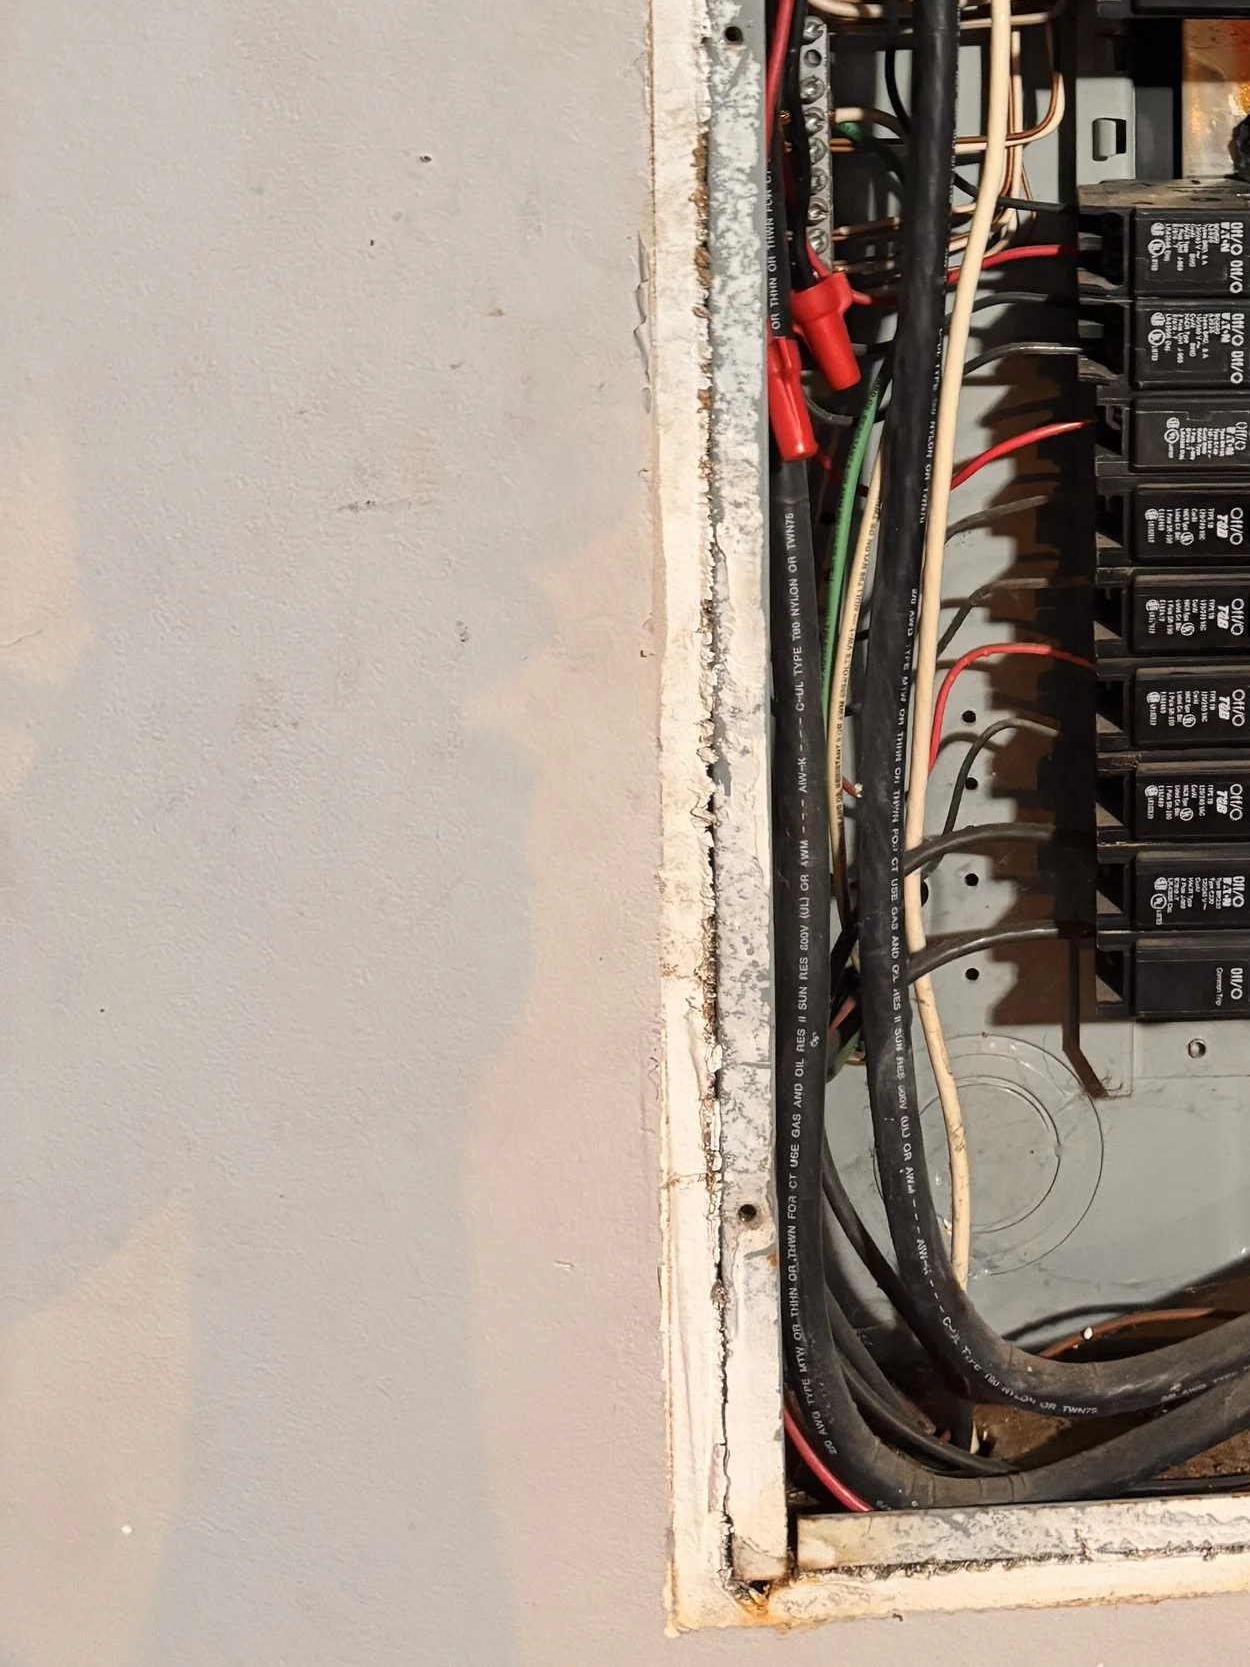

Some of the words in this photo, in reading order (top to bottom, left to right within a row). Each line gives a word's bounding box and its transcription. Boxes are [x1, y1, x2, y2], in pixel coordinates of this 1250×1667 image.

[766, 217, 776, 251] THWN
[1229, 222, 1244, 256] Off/O
[768, 255, 777, 273] OR
[1229, 260, 1244, 294] Off/O
[769, 277, 780, 308] THHN
[771, 313, 781, 330] OR
[1230, 313, 1245, 347] Off/O
[1230, 350, 1244, 384] Off/O
[926, 420, 937, 459] NYLON
[1234, 421, 1248, 451] Off/O
[1229, 507, 1244, 545] Off/O
[786, 555, 798, 574] OR
[788, 577, 800, 617] NYLON
[1230, 598, 1245, 636] Off/O
[792, 645, 803, 676] TYPE
[897, 707, 906, 725] OR
[1231, 689, 1246, 727] Off/O
[1229, 783, 1244, 821] Off/O
[799, 839, 810, 868] AWM
[890, 856, 900, 874] CT
[799, 873, 810, 892] OR
[890, 878, 900, 902] USE
[1232, 875, 1245, 908] Off/O
[799, 896, 810, 919] (UL)
[890, 906, 900, 931] GAS
[799, 924, 810, 951] 600V
[890, 935, 900, 960] AND
[798, 956, 809, 980] RES
[1215, 967, 1223, 993] Common
[1230, 967, 1243, 999] Off/O
[797, 986, 809, 1011] SUN
[1215, 993, 1223, 1006] Trip
[796, 1028, 807, 1052] RES
[894, 1027, 905, 1052] SUN
[794, 1057, 806, 1078] OIL
[895, 1056, 906, 1080] RES
[793, 1082, 804, 1109] AND
[790, 1113, 802, 1139] GAS
[899, 1115, 911, 1138] (UL)
[789, 1143, 800, 1168] USE
[902, 1143, 913, 1162] OR
[788, 1173, 799, 1191] CT
[787, 1195, 797, 1220] FOR
[787, 1225, 797, 1259] THWN
[788, 1264, 798, 1283] OR
[788, 1286, 800, 1319] THHN
[791, 1323, 804, 1342] OR
[795, 1346, 809, 1374] MTW
[800, 1377, 818, 1406] TYPE
[1039, 1400, 1057, 1412] OR
[812, 1410, 828, 1437] AWG
